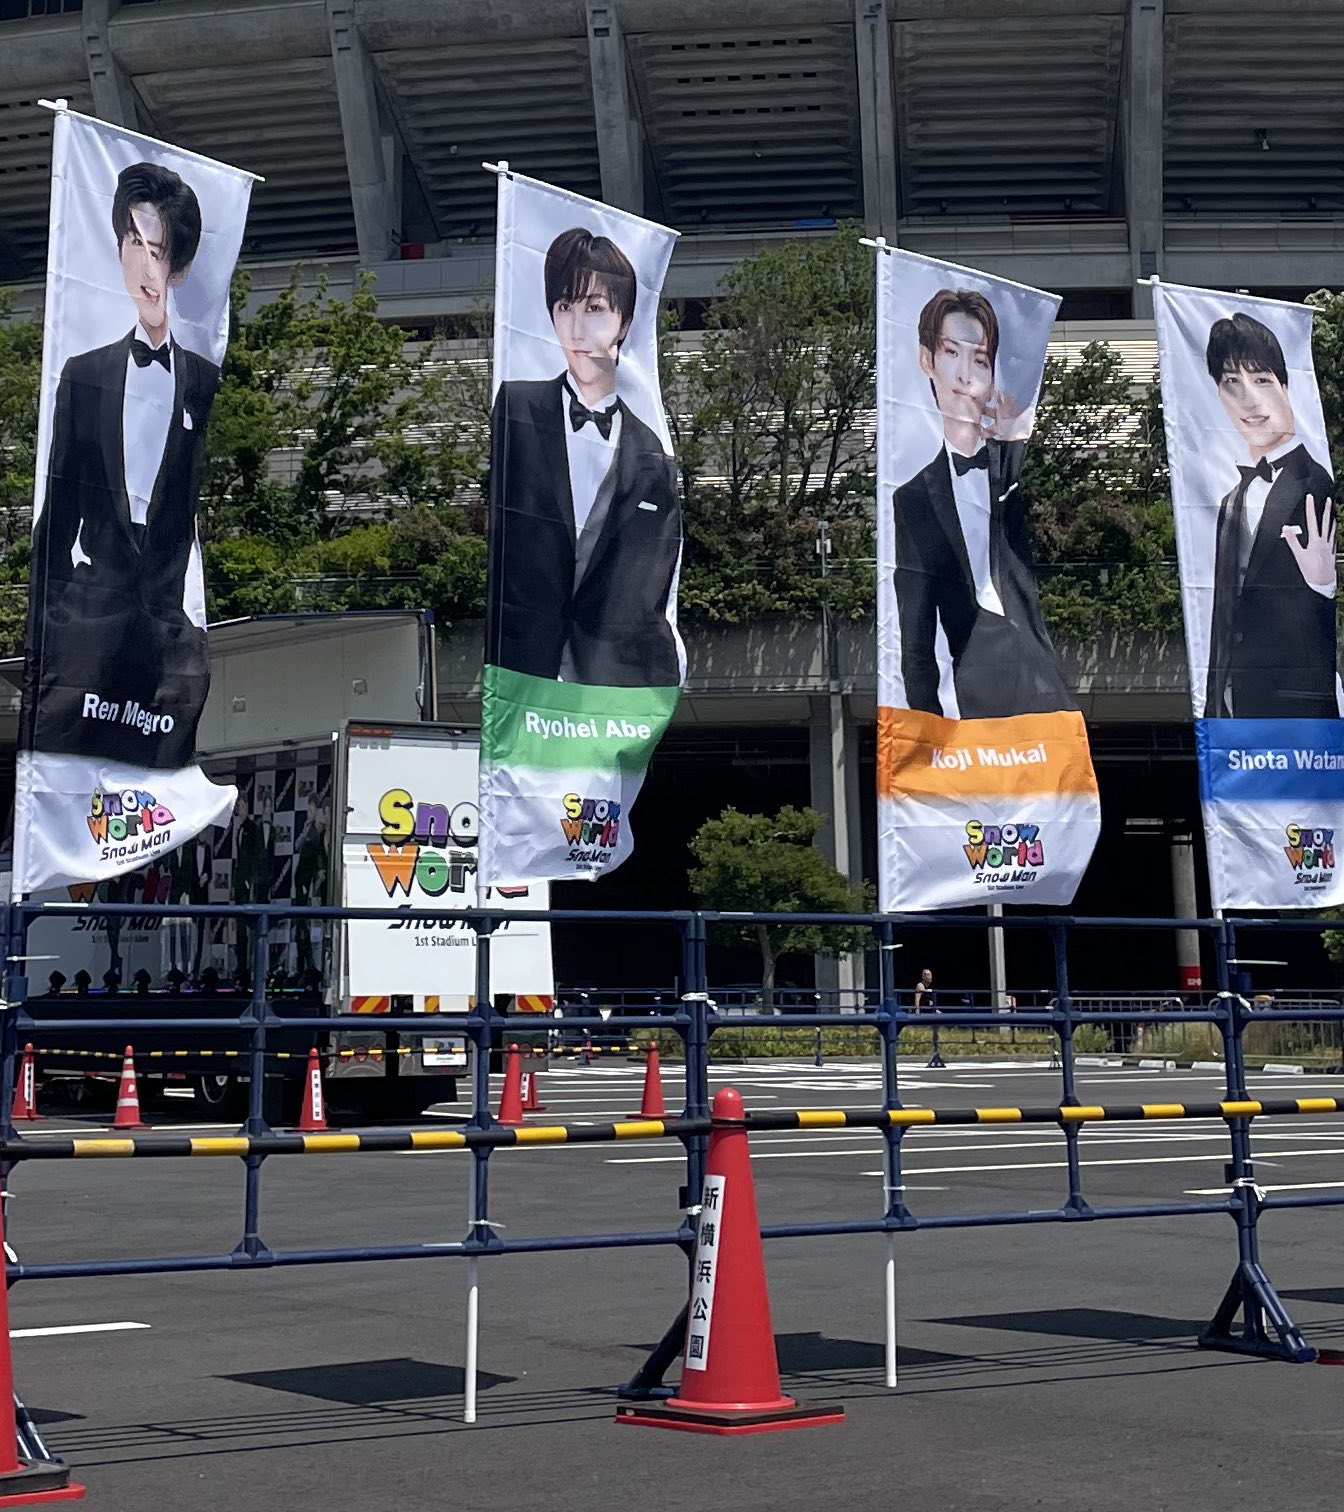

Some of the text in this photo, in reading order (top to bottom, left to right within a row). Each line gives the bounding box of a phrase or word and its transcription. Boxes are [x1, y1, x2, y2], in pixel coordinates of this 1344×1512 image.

[82, 693, 175, 736] Ren Megro
[525, 711, 652, 740] Ryohei Abe
[931, 743, 1047, 771] Koji Mukai
[1228, 749, 1289, 771] Shota
[91, 788, 157, 818] Snow
[562, 793, 622, 823] Snow
[86, 802, 177, 845] World
[378, 788, 479, 849] Sno
[965, 819, 1040, 847] Snow
[99, 829, 171, 862] Snow Man
[560, 819, 620, 848] World
[1285, 823, 1334, 848] Snow
[962, 840, 1045, 870] World
[1283, 843, 1335, 870] World
[414, 936, 429, 947] 1st
[431, 935, 470, 947] Stadium
